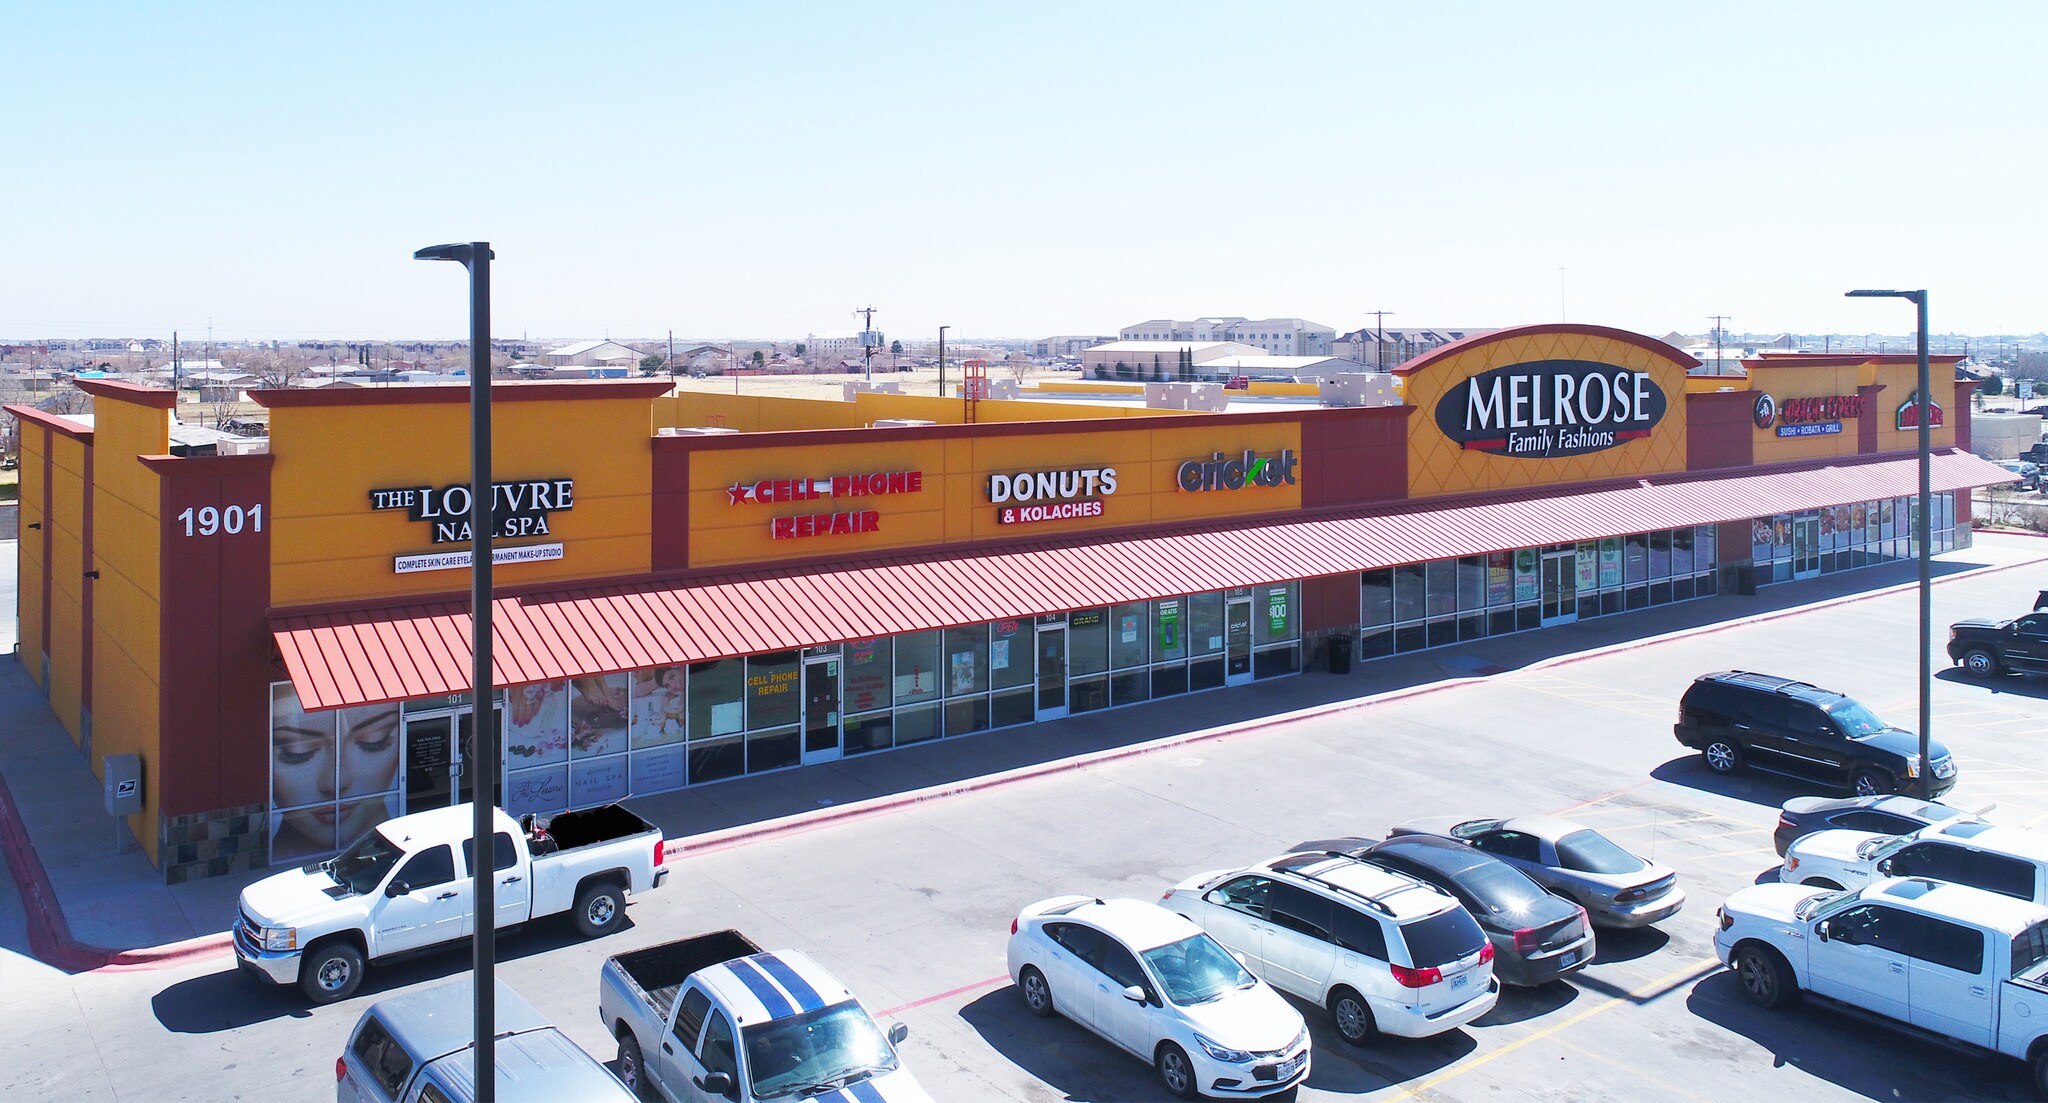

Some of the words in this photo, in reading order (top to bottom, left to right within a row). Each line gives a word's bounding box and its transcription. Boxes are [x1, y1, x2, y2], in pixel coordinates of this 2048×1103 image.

[1465, 371, 1650, 431] MELROSE
[1780, 427, 1797, 437] SUSHI
[1800, 425, 1821, 435] ROBATA
[1825, 423, 1841, 433] GRILL
[1508, 428, 1554, 456] Family
[1558, 426, 1614, 449] Fashions
[1176, 449, 1298, 492] cricket
[754, 478, 821, 504] CELL
[829, 471, 923, 498] PHONE
[989, 467, 1118, 503] DONUTS
[373, 490, 415, 509] THE
[178, 503, 262, 537] 1901
[1003, 509, 1015, 524] &
[1020, 501, 1102, 522] KOLACHES
[504, 516, 550, 537] SPA
[771, 510, 880, 540] REPAIR
[397, 559, 427, 570] COMPLETE
[428, 558, 441, 568] SKIN
[441, 556, 457, 566] CARE
[518, 549, 543, 559] MAKE-UP
[542, 547, 562, 558] STUDIO
[1045, 613, 1056, 622] 104
[1073, 615, 1099, 626] GRAND
[1269, 603, 1287, 619] $100
[995, 620, 1019, 633] OPEN
[748, 676, 768, 687] CELL
[770, 671, 799, 682] PHONE
[447, 693, 462, 704] 101
[758, 683, 788, 696] REPAIR
[575, 777, 598, 787] NAIL
[606, 774, 622, 782] SPA
